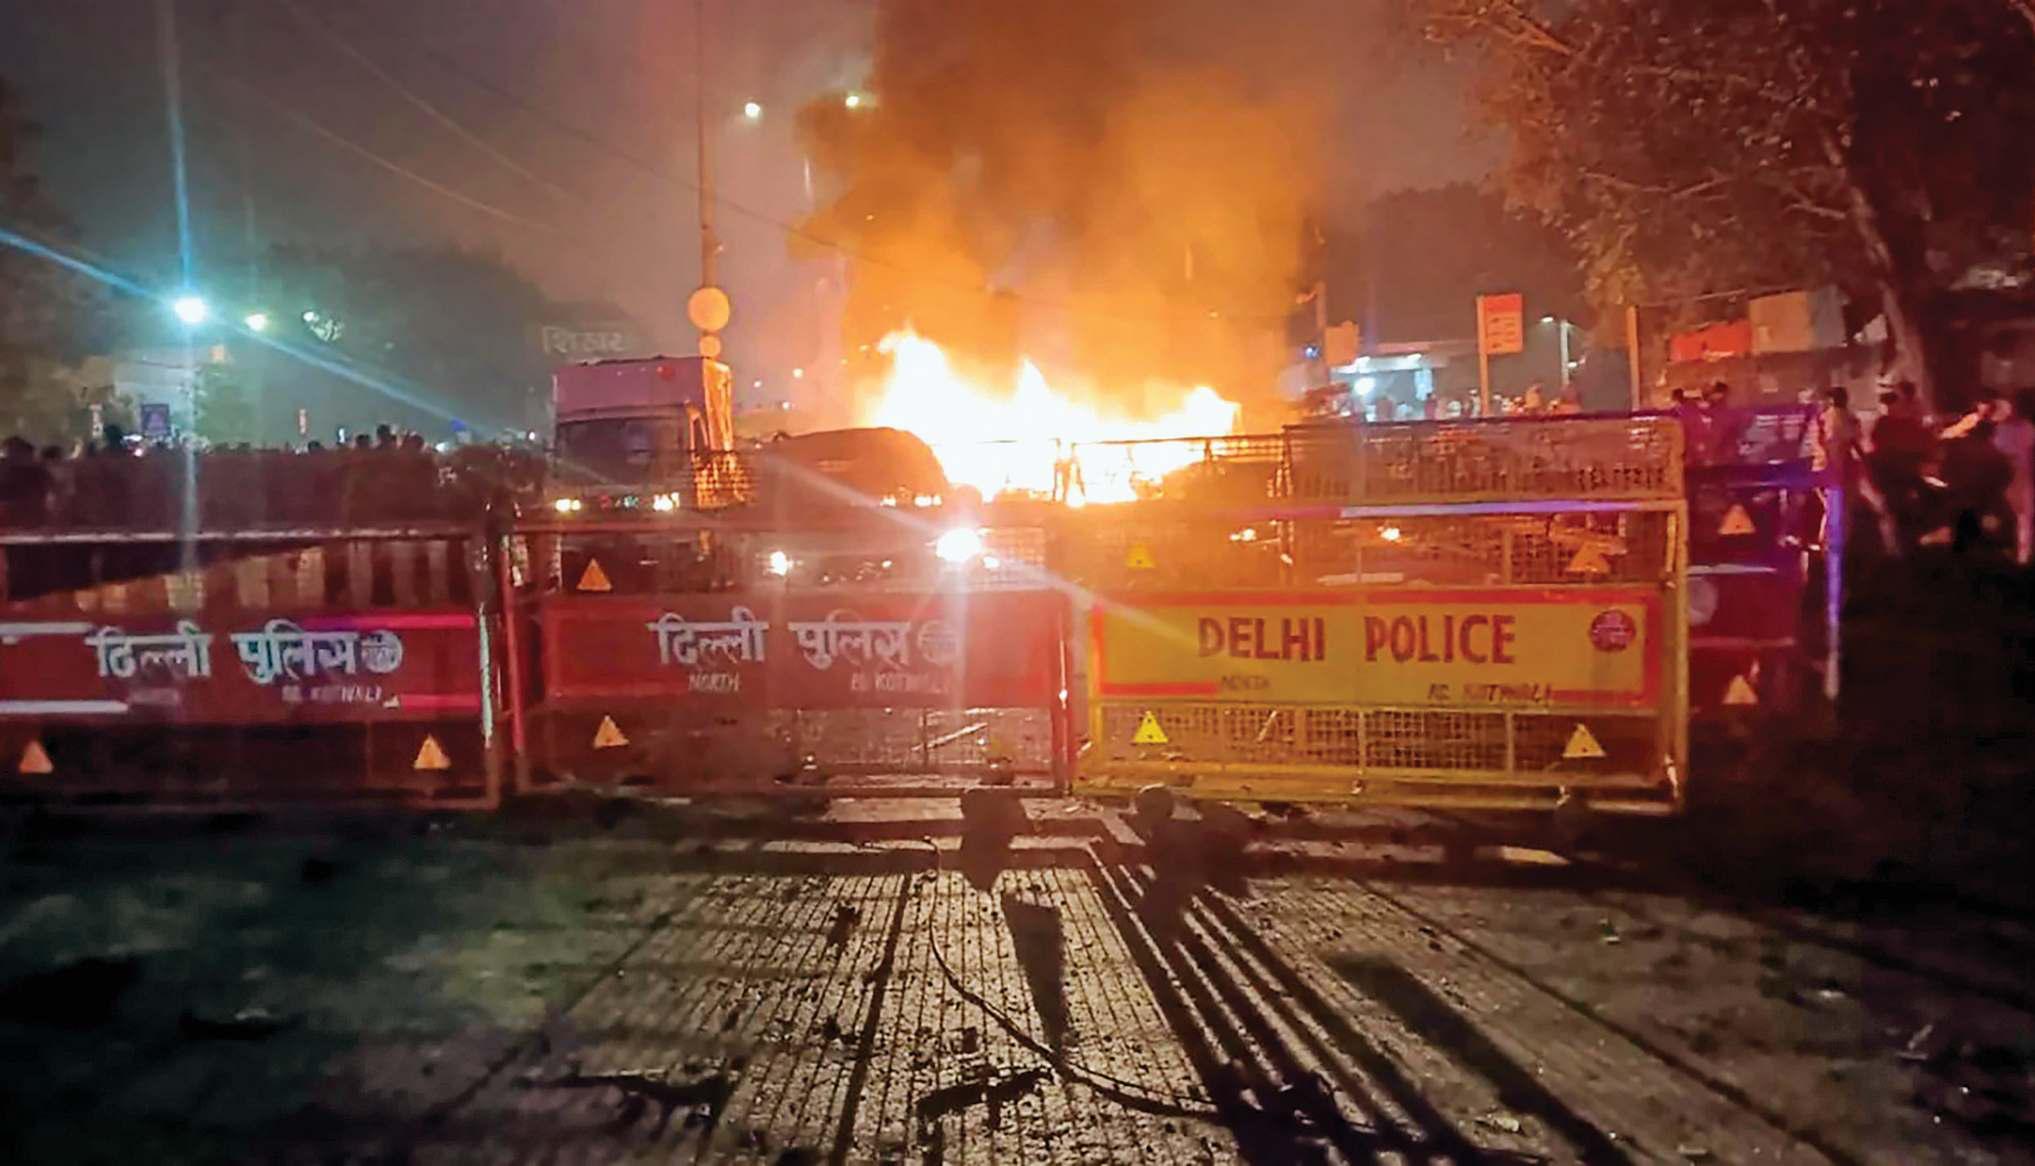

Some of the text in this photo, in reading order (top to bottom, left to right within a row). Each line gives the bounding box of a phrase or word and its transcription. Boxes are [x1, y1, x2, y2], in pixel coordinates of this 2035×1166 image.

[84, 619, 359, 685] दिल्ली पुलिस
[646, 606, 911, 671] दिल्ली पुलिस
[1198, 614, 1516, 664] DELHI POLICE
